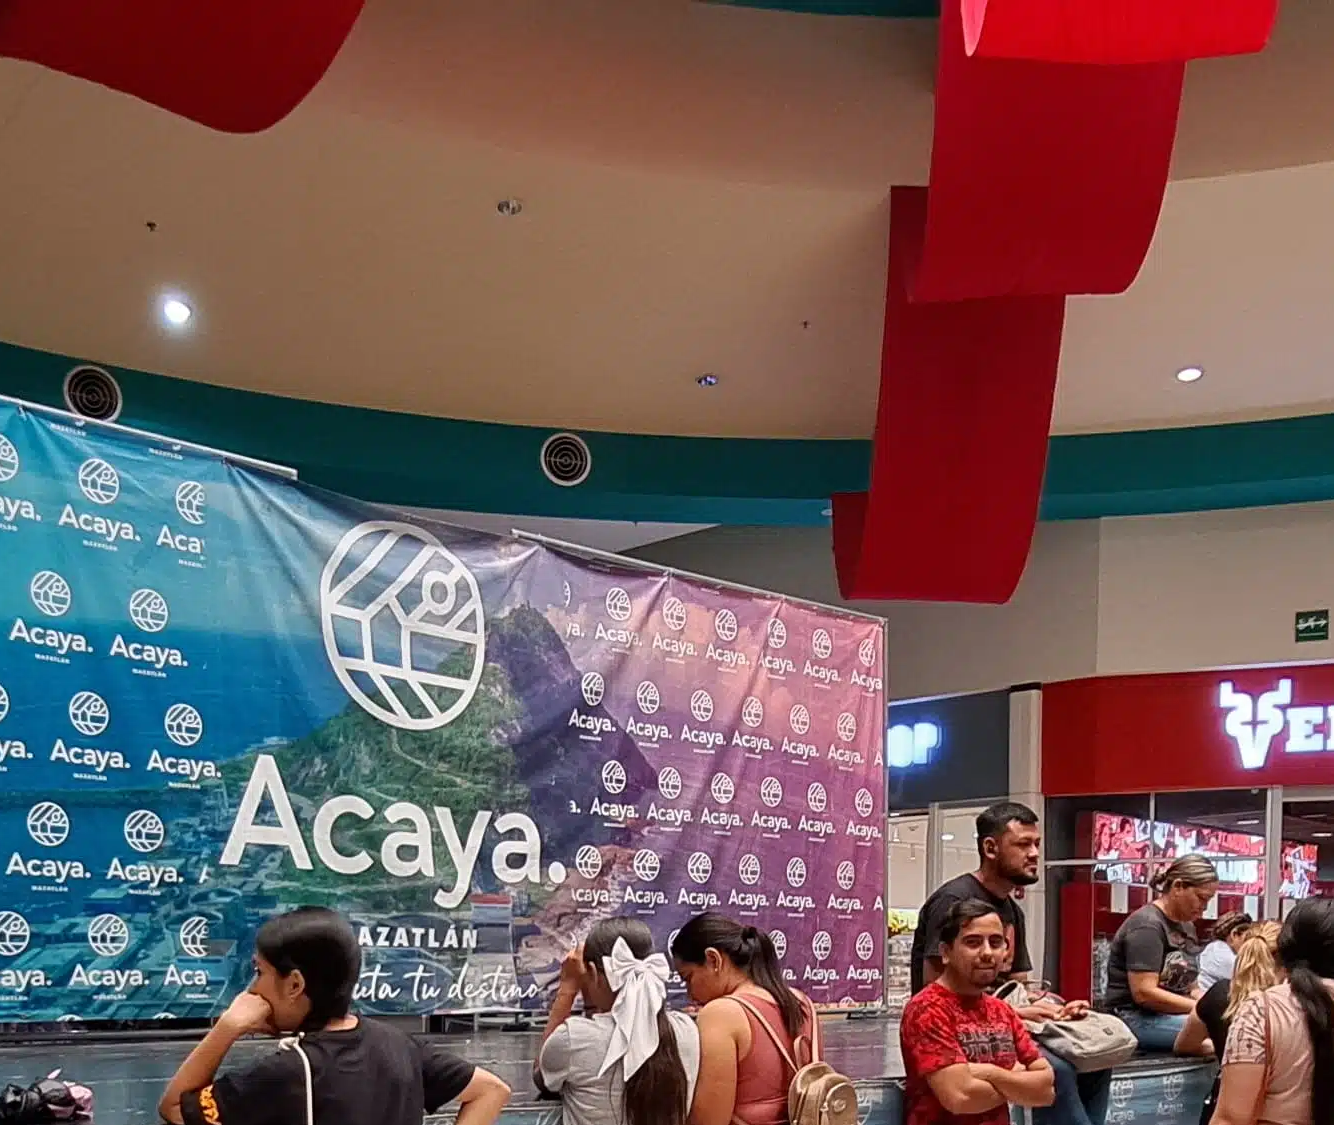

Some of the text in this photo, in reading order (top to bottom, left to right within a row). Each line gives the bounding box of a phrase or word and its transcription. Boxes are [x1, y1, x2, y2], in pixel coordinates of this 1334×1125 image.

[58, 504, 141, 543] Acaya.
[9, 618, 93, 654] Acaya.
[595, 622, 643, 648] Acaya.
[652, 632, 697, 657] Acaya.
[110, 635, 188, 669] Acaya.
[706, 642, 749, 667] Acaya.
[804, 659, 841, 682] Acaya.
[569, 708, 616, 734] Acaya.
[626, 717, 672, 741] Acaya.
[681, 724, 727, 747] Acaya.
[732, 730, 774, 753] Acaya.
[781, 736, 819, 759] Acaya.
[50, 739, 131, 770] Acaya.
[147, 749, 222, 781] Acaya.
[828, 743, 864, 766] Acaya.
[590, 797, 639, 821] Acaya.
[647, 802, 694, 826] Acaya.
[701, 808, 743, 831] Acaya.
[220, 754, 566, 909] Acaya.
[751, 810, 791, 833] Acaya.
[798, 815, 835, 837] Acaya.
[846, 821, 882, 842] Acaya.
[6, 852, 91, 883] Acaya.
[106, 858, 184, 887] Acaya.
[624, 886, 668, 908] Acaya.
[678, 888, 721, 910] Acaya.
[728, 888, 769, 910] Acaya.
[777, 891, 815, 912] Acaya.
[828, 893, 863, 914] Acaya.
[359, 924, 478, 948] AZATLÁN
[69, 964, 149, 990] Acaya.
[403, 963, 441, 1002] tu
[448, 963, 544, 1001] destino
[803, 965, 839, 984] Acaya.
[847, 965, 882, 983] Acaya.
